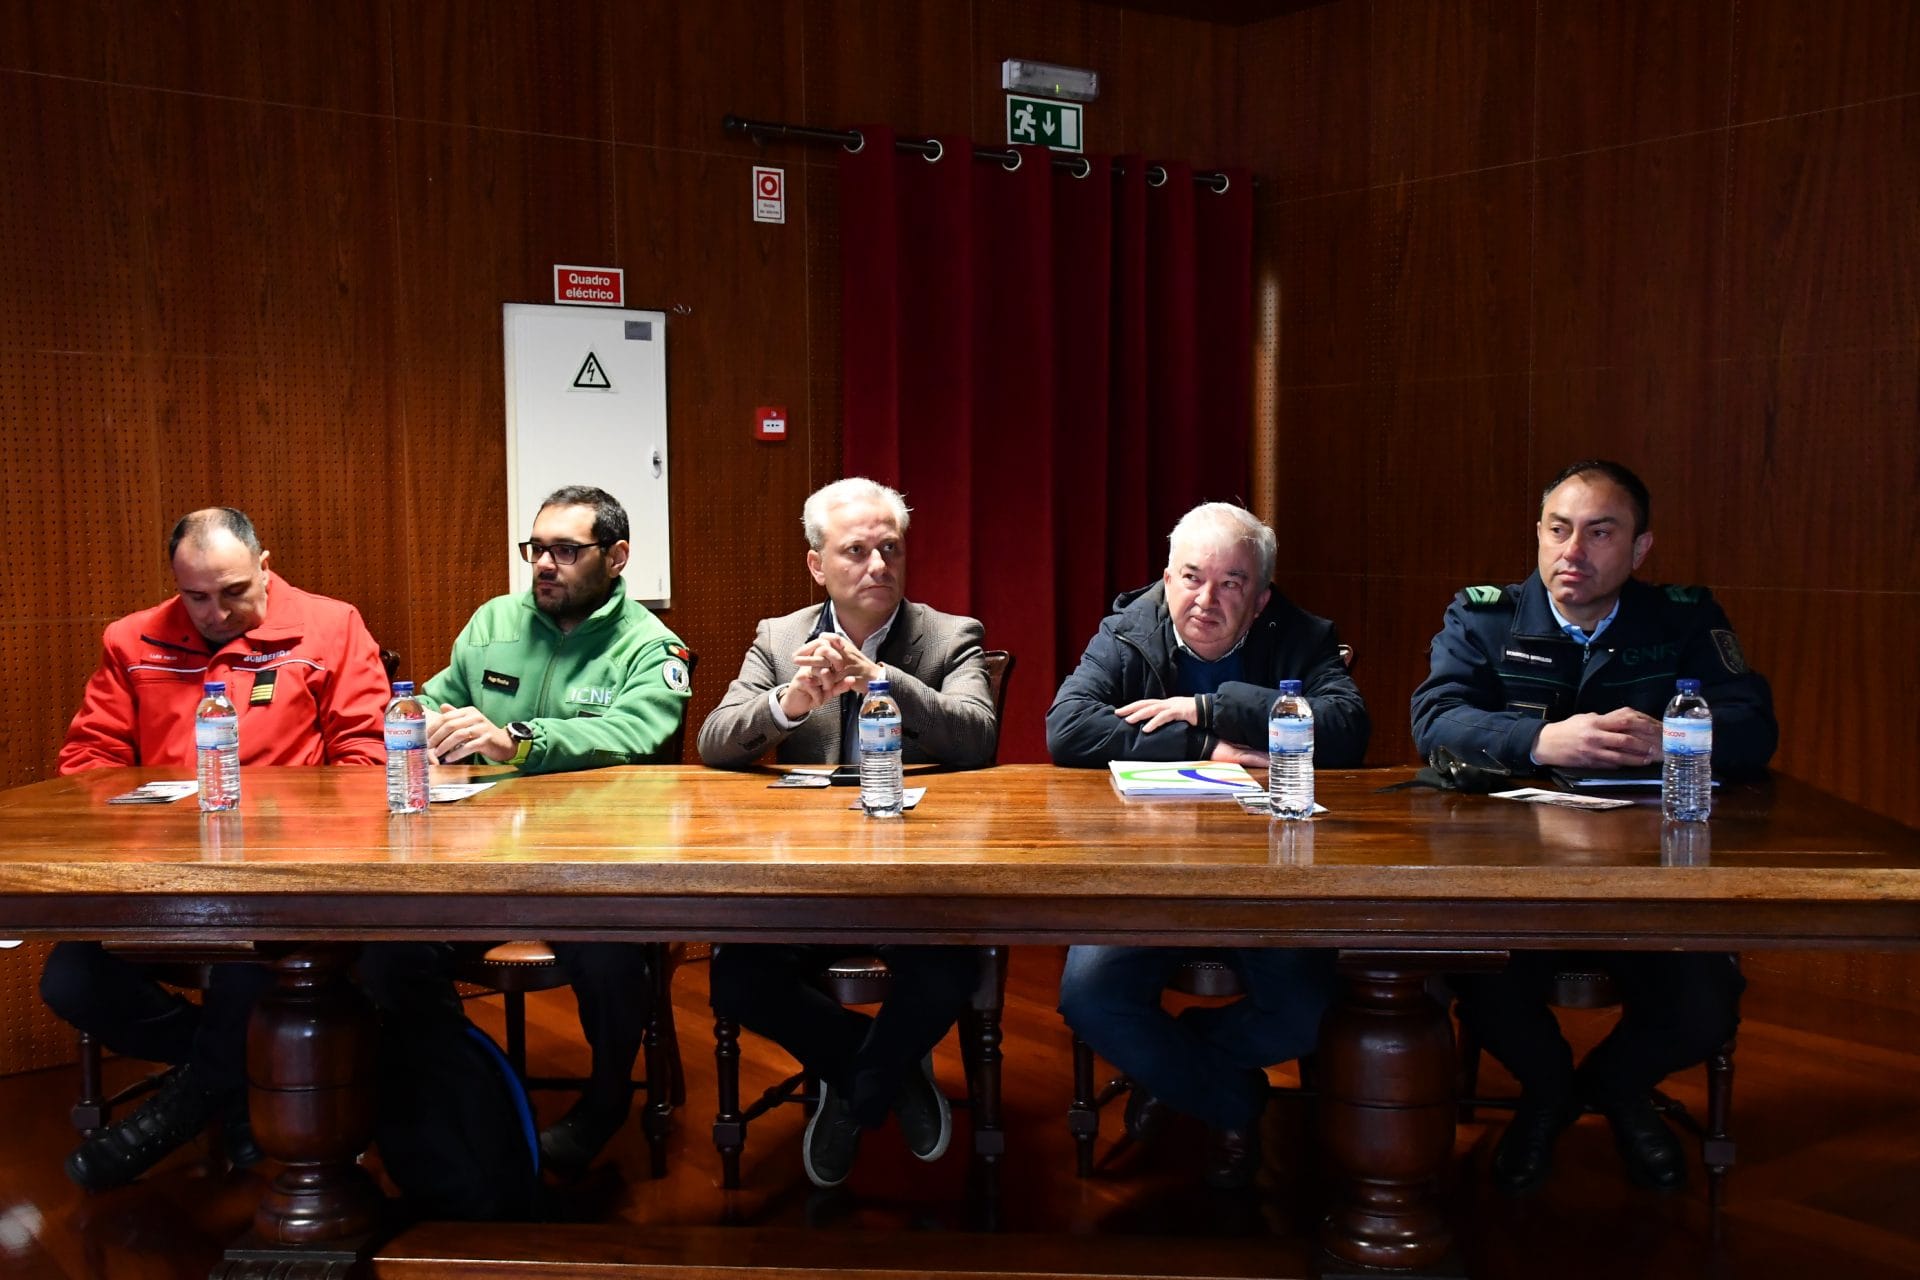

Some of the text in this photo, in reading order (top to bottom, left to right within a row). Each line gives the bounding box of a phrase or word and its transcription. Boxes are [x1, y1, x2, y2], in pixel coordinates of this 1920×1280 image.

[568, 273, 611, 286] Quadro
[566, 287, 614, 300] eléctrico
[1622, 643, 1677, 666] GNR
[571, 688, 612, 704] ICNF
